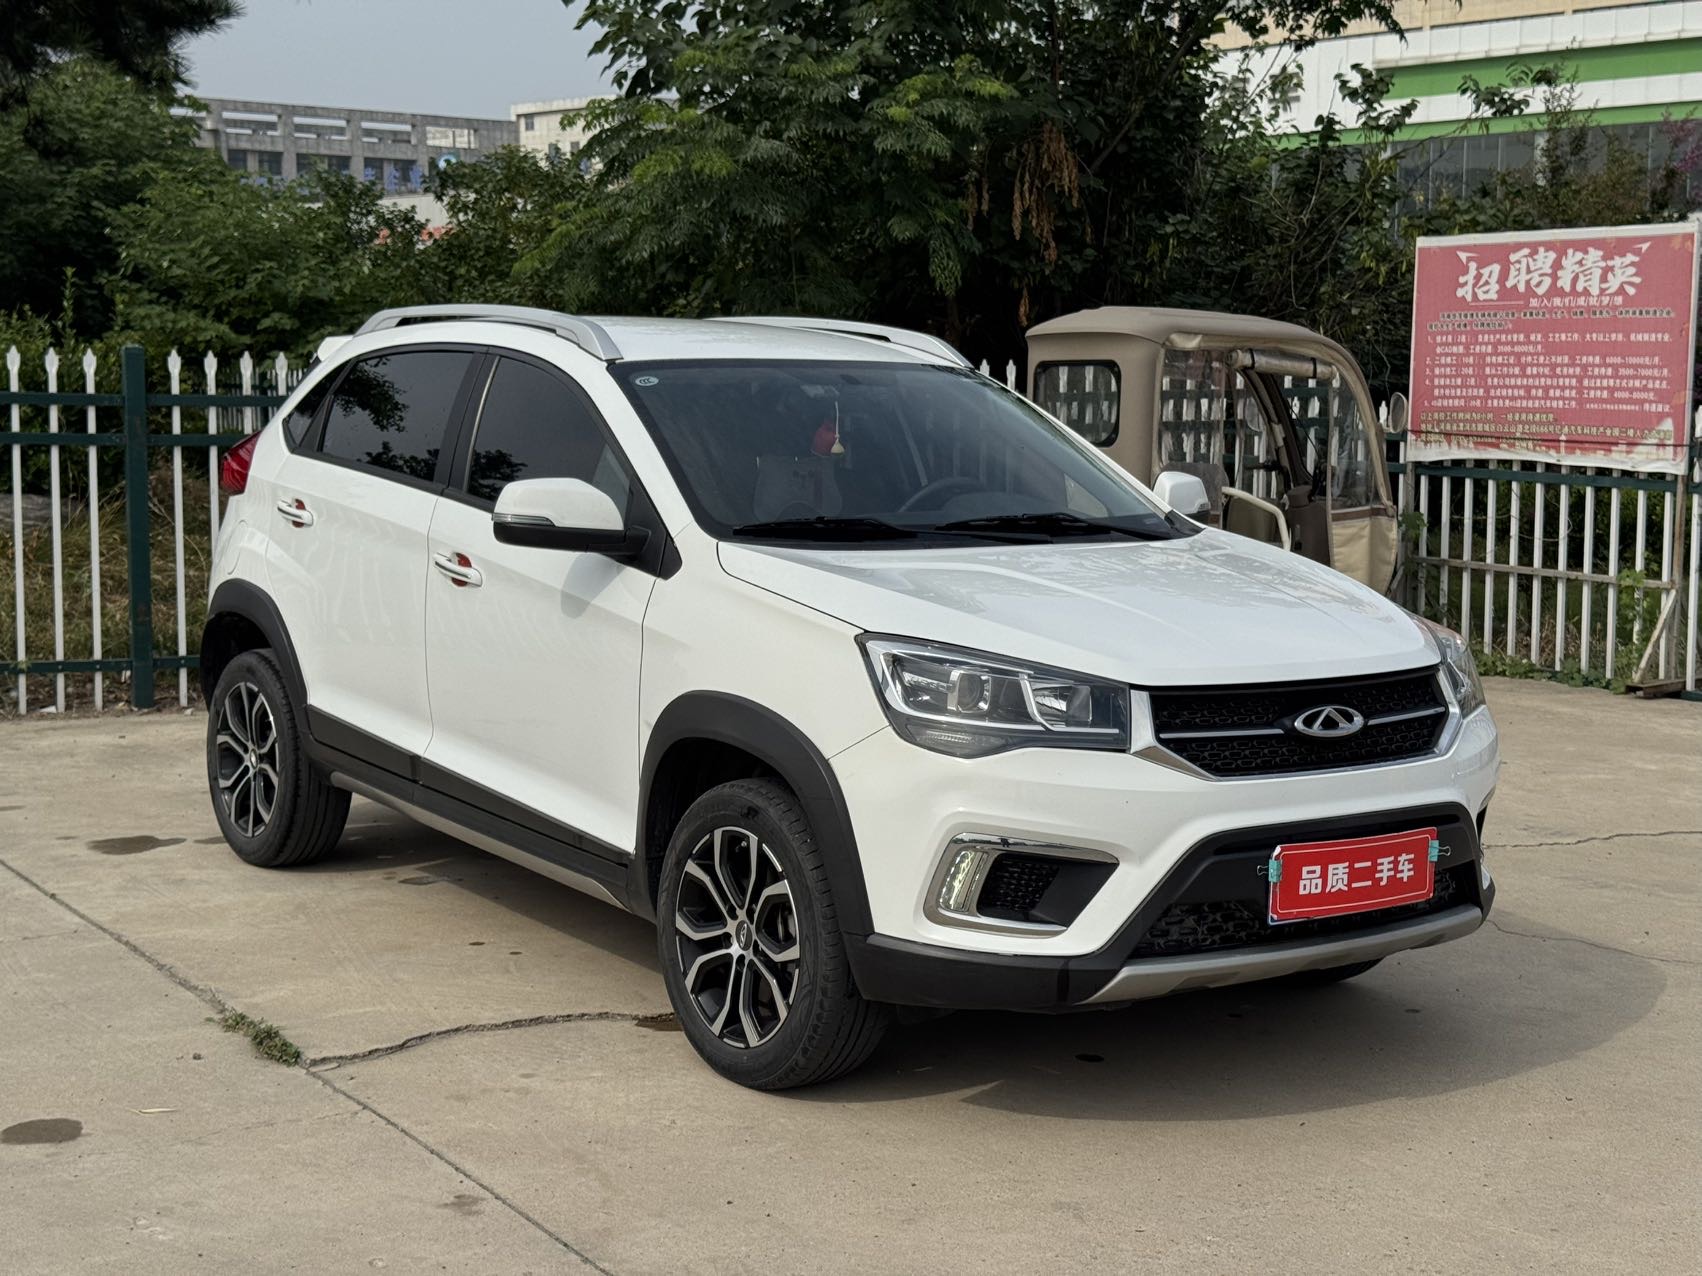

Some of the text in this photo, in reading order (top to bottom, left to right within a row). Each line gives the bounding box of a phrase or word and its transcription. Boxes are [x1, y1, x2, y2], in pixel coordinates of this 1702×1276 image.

[1456, 247, 1642, 302] 招聘精英
[1299, 853, 1415, 895] 品质二手车
